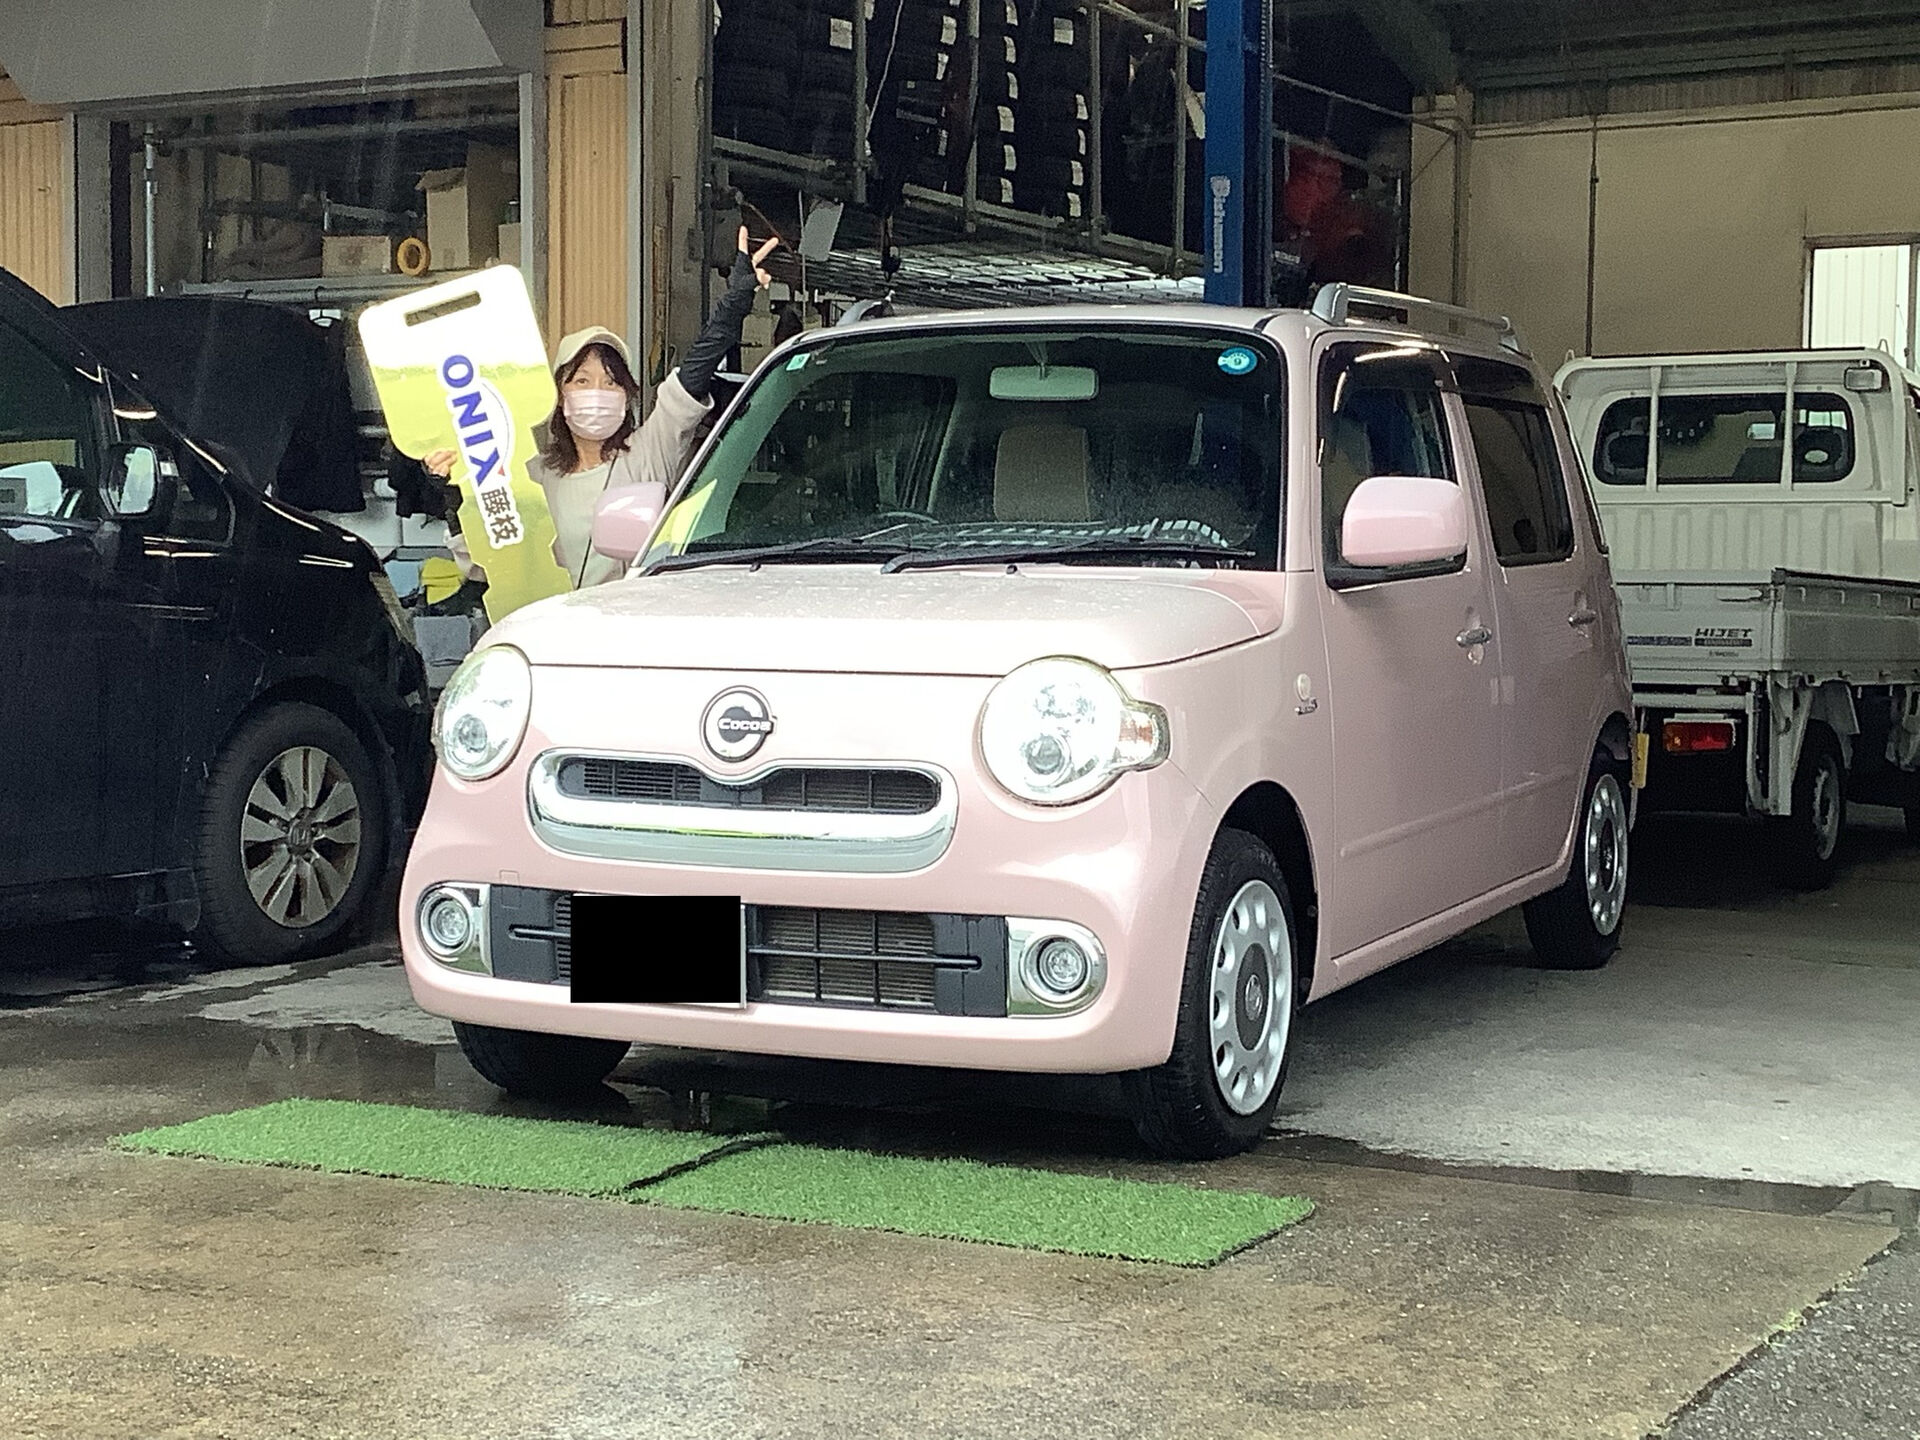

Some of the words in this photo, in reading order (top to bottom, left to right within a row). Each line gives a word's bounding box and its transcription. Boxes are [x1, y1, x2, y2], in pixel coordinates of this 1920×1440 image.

[442, 354, 500, 487] ONIX
[481, 486, 519, 543] 藤枝
[1695, 628, 1753, 638] HIJET
